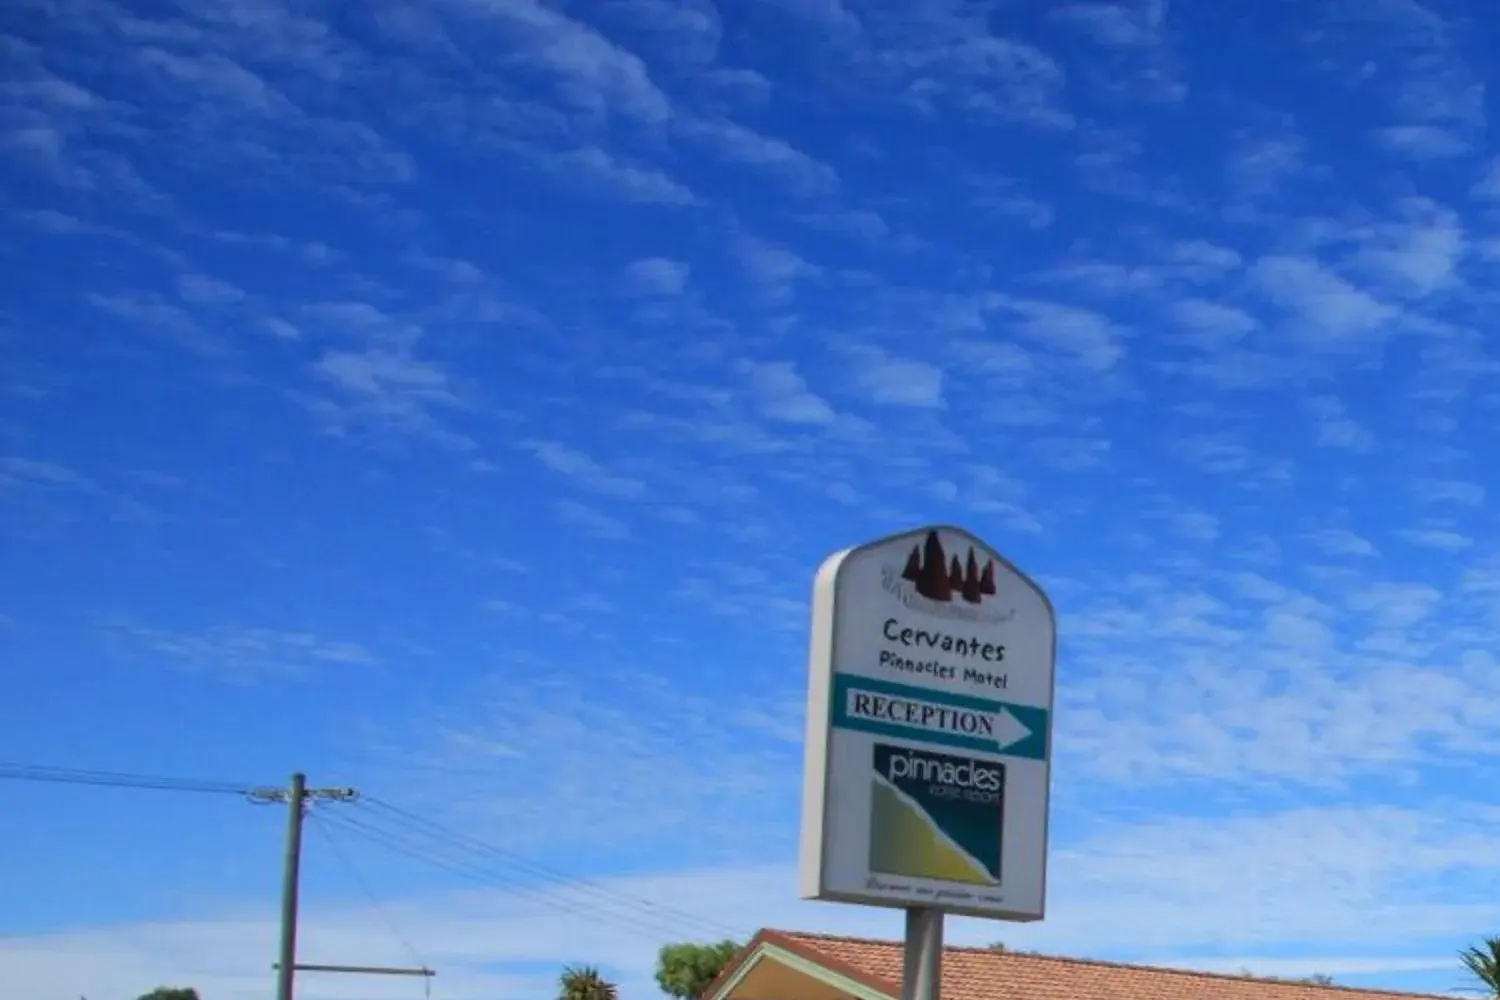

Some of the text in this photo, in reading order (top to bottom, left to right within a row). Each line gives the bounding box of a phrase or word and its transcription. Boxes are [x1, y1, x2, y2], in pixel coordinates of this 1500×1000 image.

[883, 618, 1006, 662] Cervantes
[879, 650, 1008, 689] Pinnacles Motel
[854, 693, 995, 735] RECEPTION
[889, 750, 1001, 791] pinnacles
